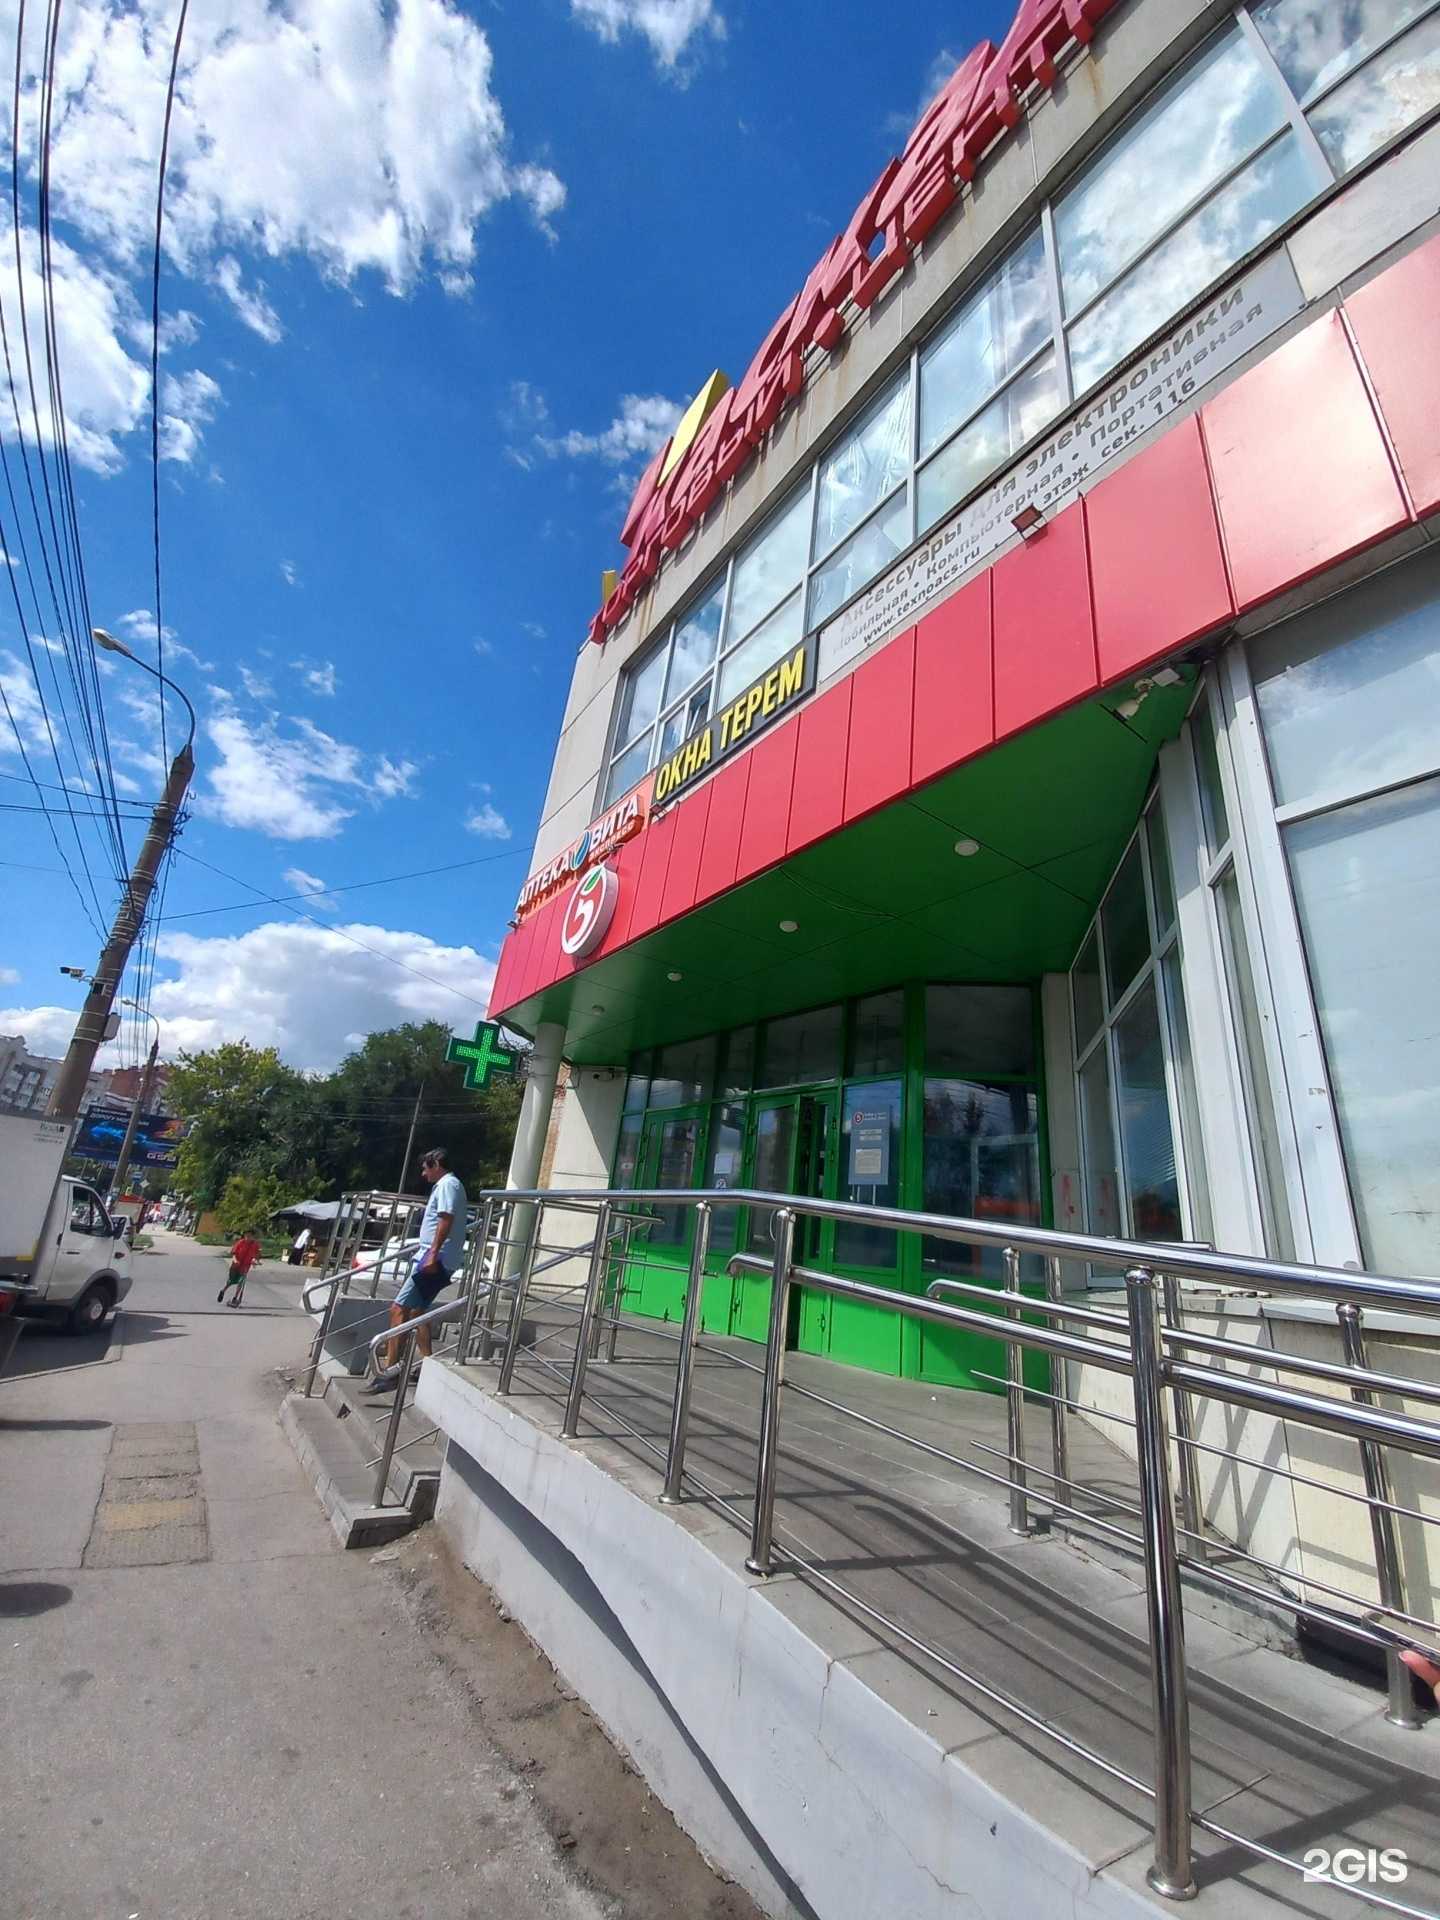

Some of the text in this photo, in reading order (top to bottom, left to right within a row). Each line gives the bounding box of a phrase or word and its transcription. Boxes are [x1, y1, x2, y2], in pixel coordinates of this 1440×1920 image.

[589, 350, 792, 633] ТОРГОВЫЙ
[841, 523, 962, 632] Аксессуары
[1026, 287, 1243, 478] электроники
[927, 463, 1063, 579] Компьютерная
[1090, 303, 1263, 447] Портативная
[1043, 376, 1196, 504] этаж сек. 116
[863, 546, 980, 643] www.texnoacs.ru
[655, 648, 805, 800] ОКНА ТЕРЕМ
[514, 794, 639, 912] АПТЕКА ВИТА
